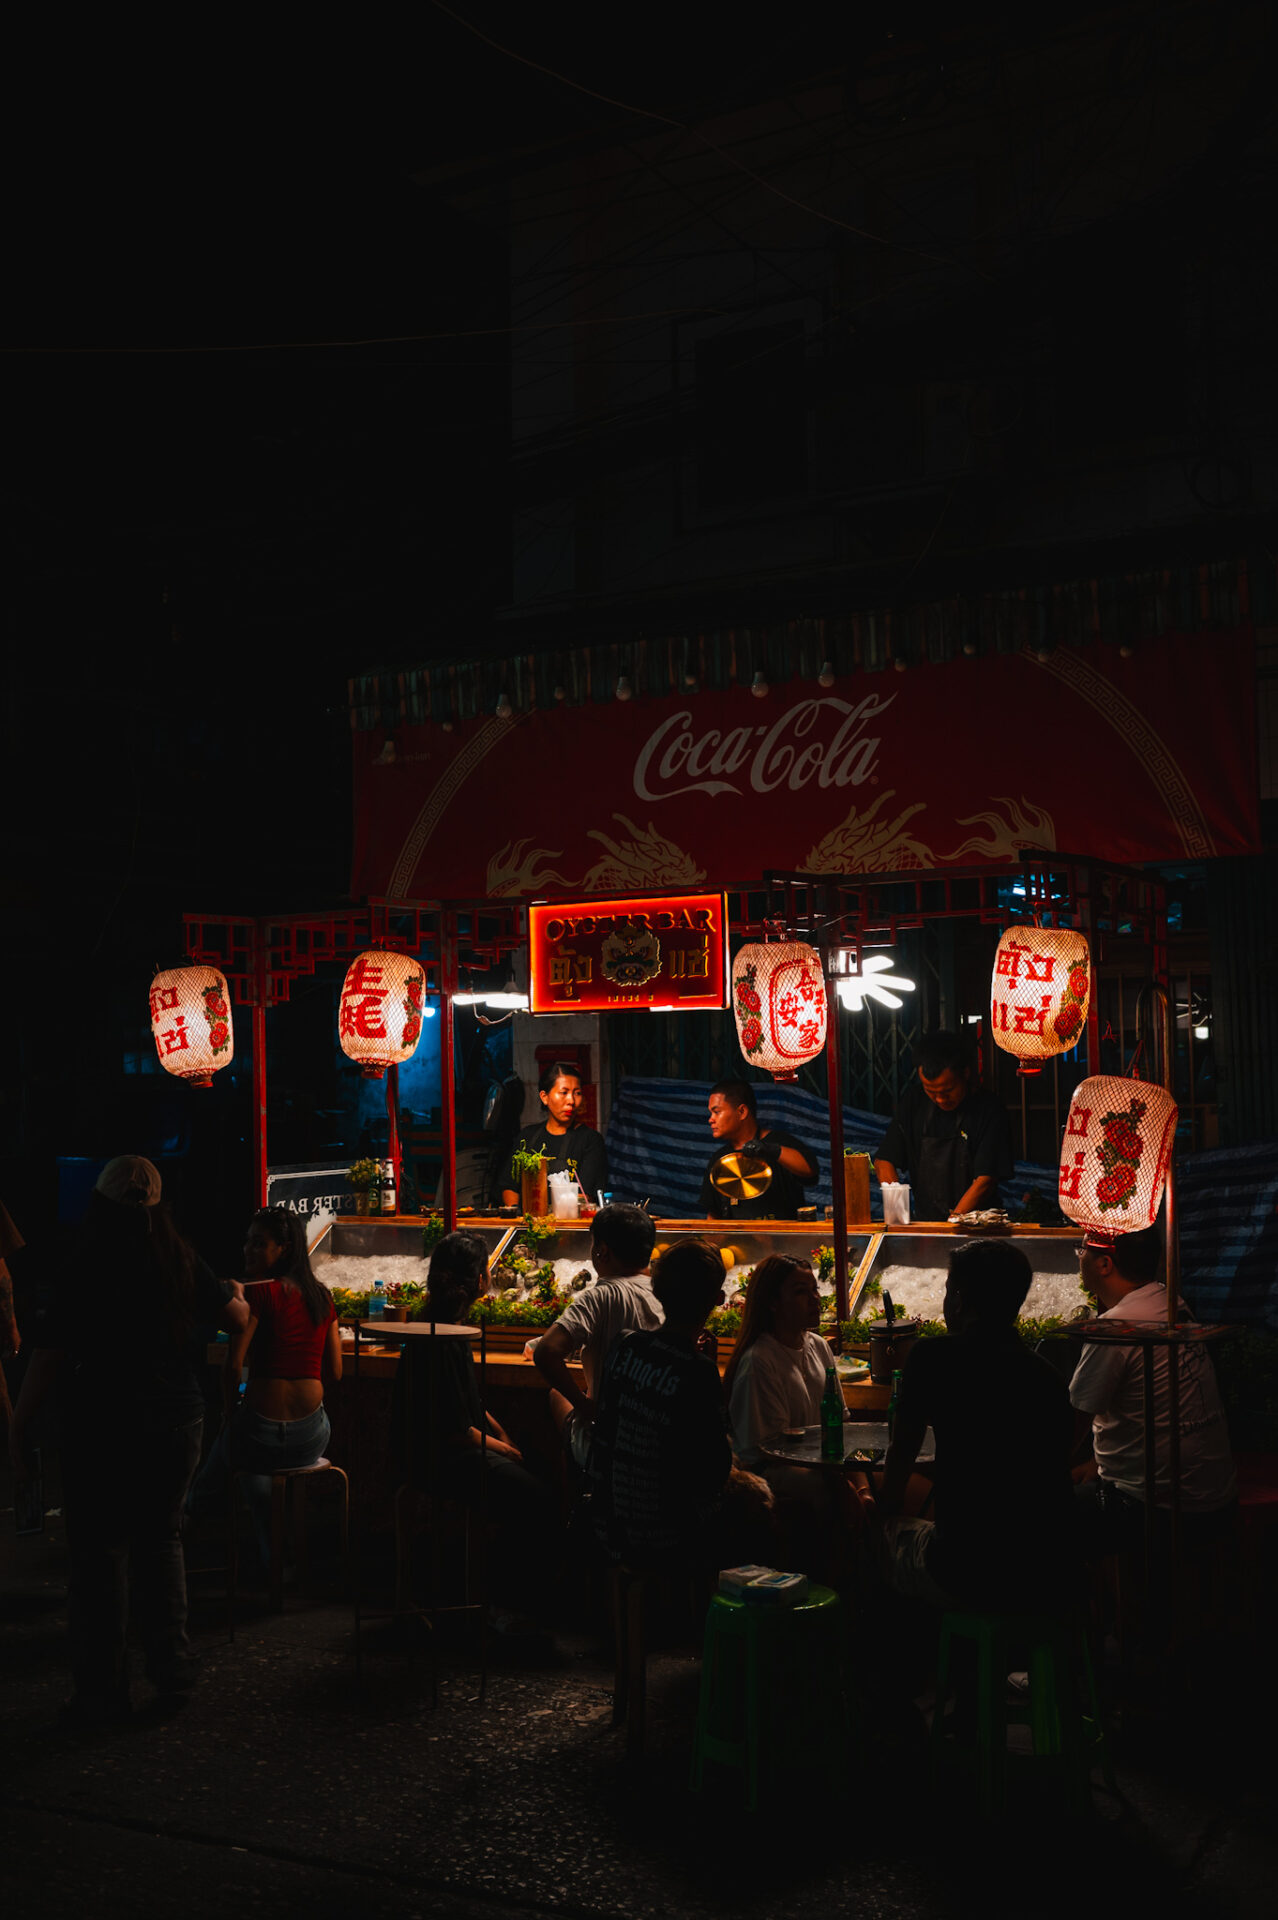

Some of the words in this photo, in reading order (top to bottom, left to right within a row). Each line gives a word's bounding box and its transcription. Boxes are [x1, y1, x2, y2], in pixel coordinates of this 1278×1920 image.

[633, 690, 898, 801] Coca-Cola
[546, 914, 654, 941] OYSTER
[657, 908, 717, 932] BAR
